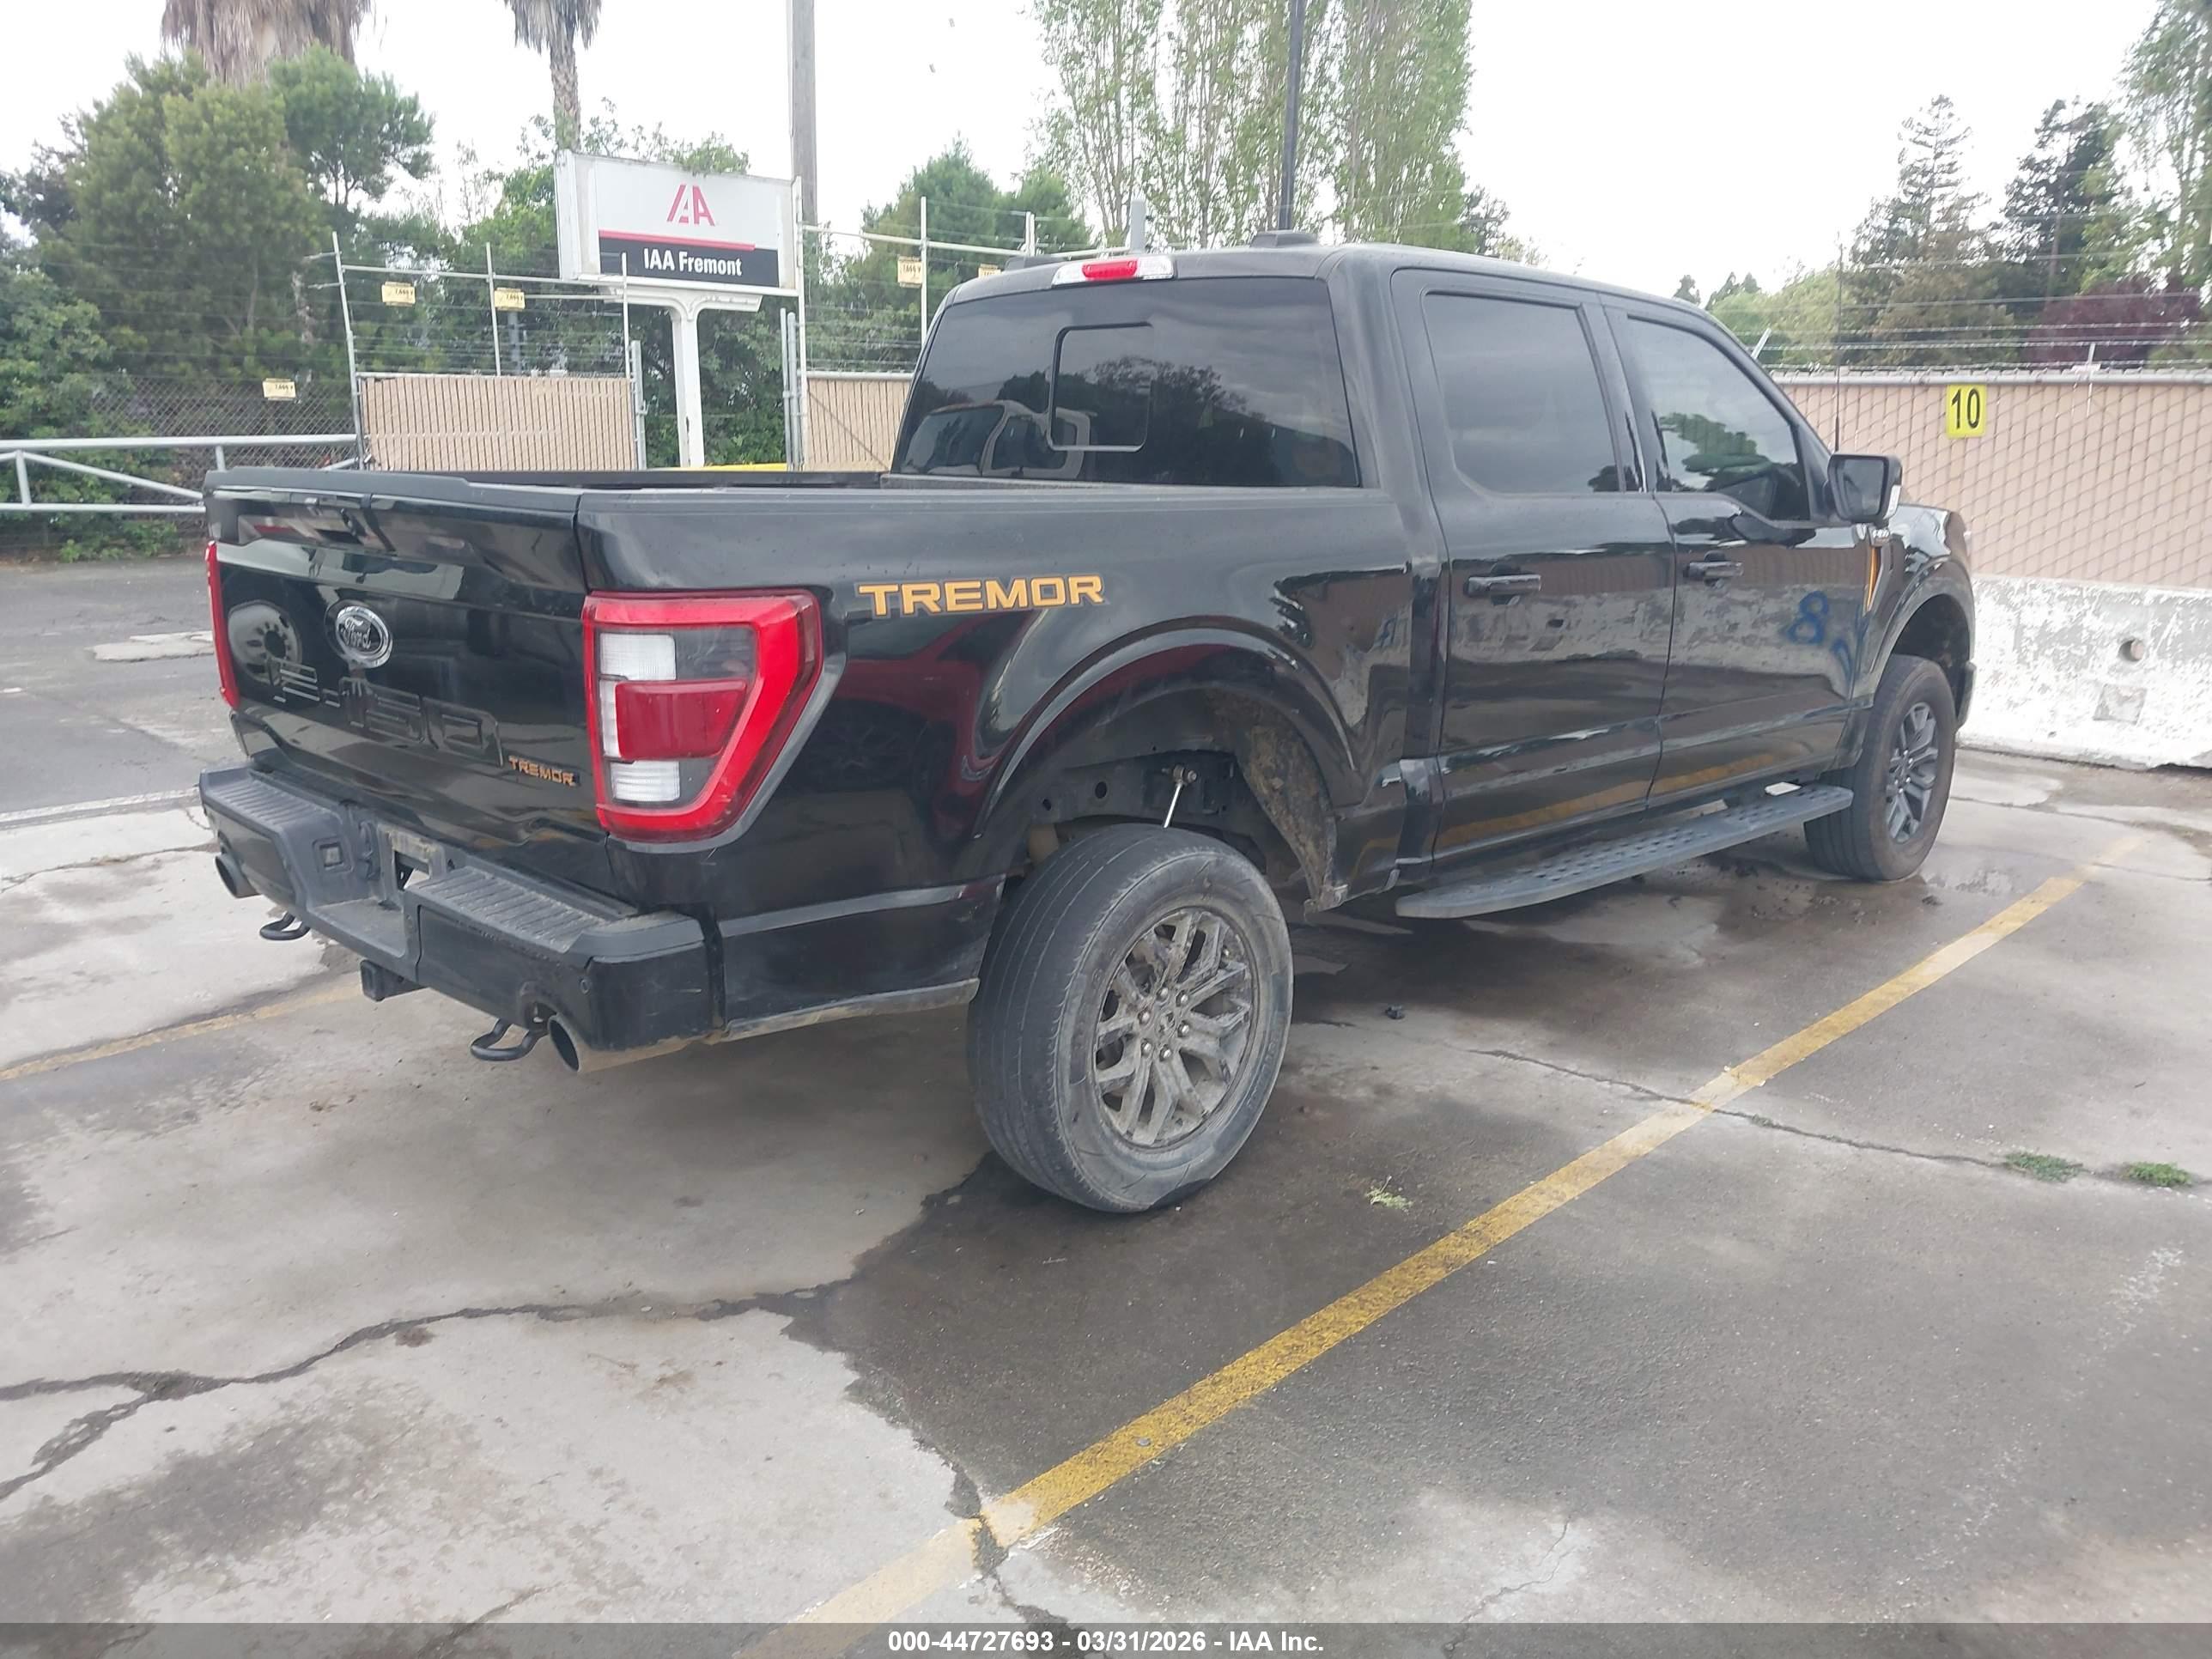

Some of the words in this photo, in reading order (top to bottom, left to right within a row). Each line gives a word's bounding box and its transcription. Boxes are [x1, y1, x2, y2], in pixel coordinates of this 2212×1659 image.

[644, 247, 675, 272] IAA
[678, 251, 743, 276] Fremont
[1950, 388, 1981, 429] 10
[858, 574, 1105, 616] TREMOR
[340, 617, 372, 650] Ford
[508, 755, 577, 787] TREMOR
